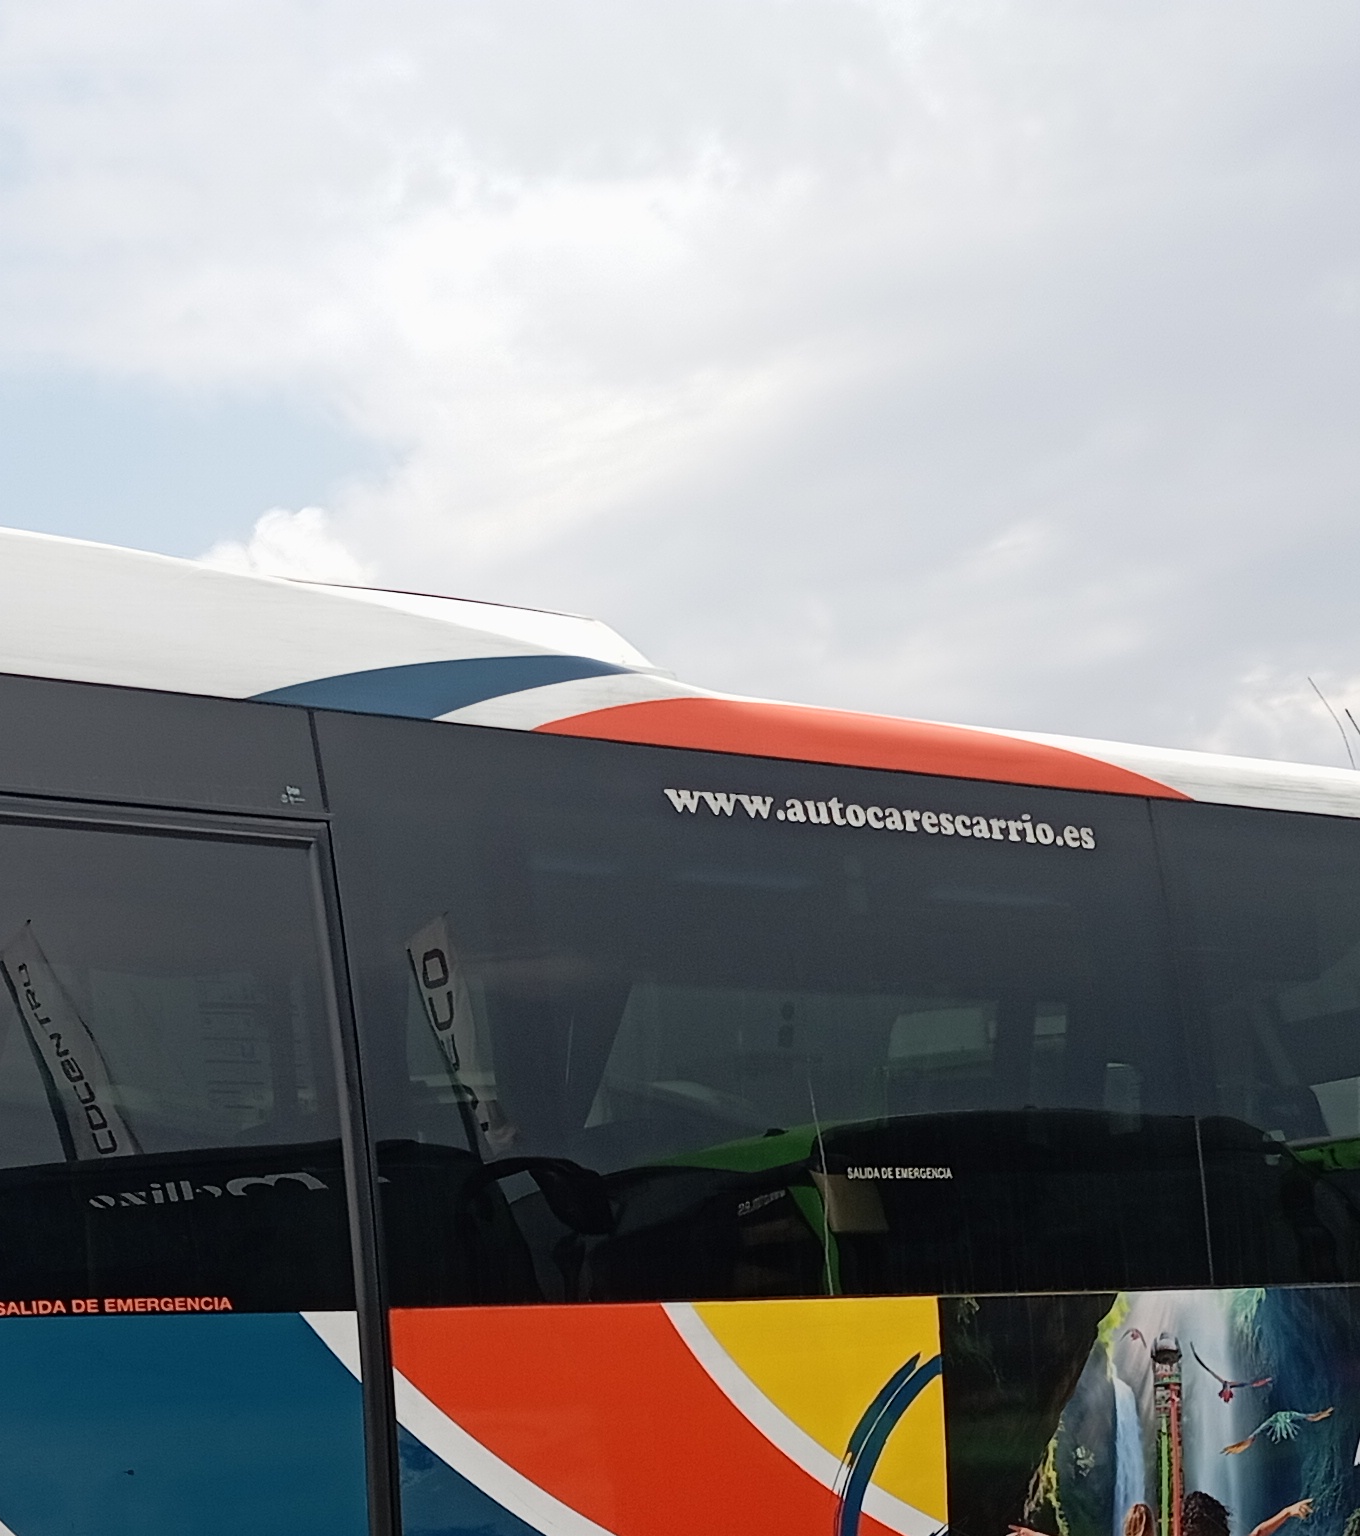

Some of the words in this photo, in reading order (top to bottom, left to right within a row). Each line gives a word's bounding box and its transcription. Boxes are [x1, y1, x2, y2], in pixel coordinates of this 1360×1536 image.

[663, 787, 1096, 850] www.autocarescarrio.es
[847, 1166, 880, 1180] SALIDA
[881, 1167, 893, 1180] DE
[895, 1166, 953, 1180] EMERGENCIA
[71, 1298, 99, 1314] DE
[104, 1296, 233, 1313] EMERGENCIA
